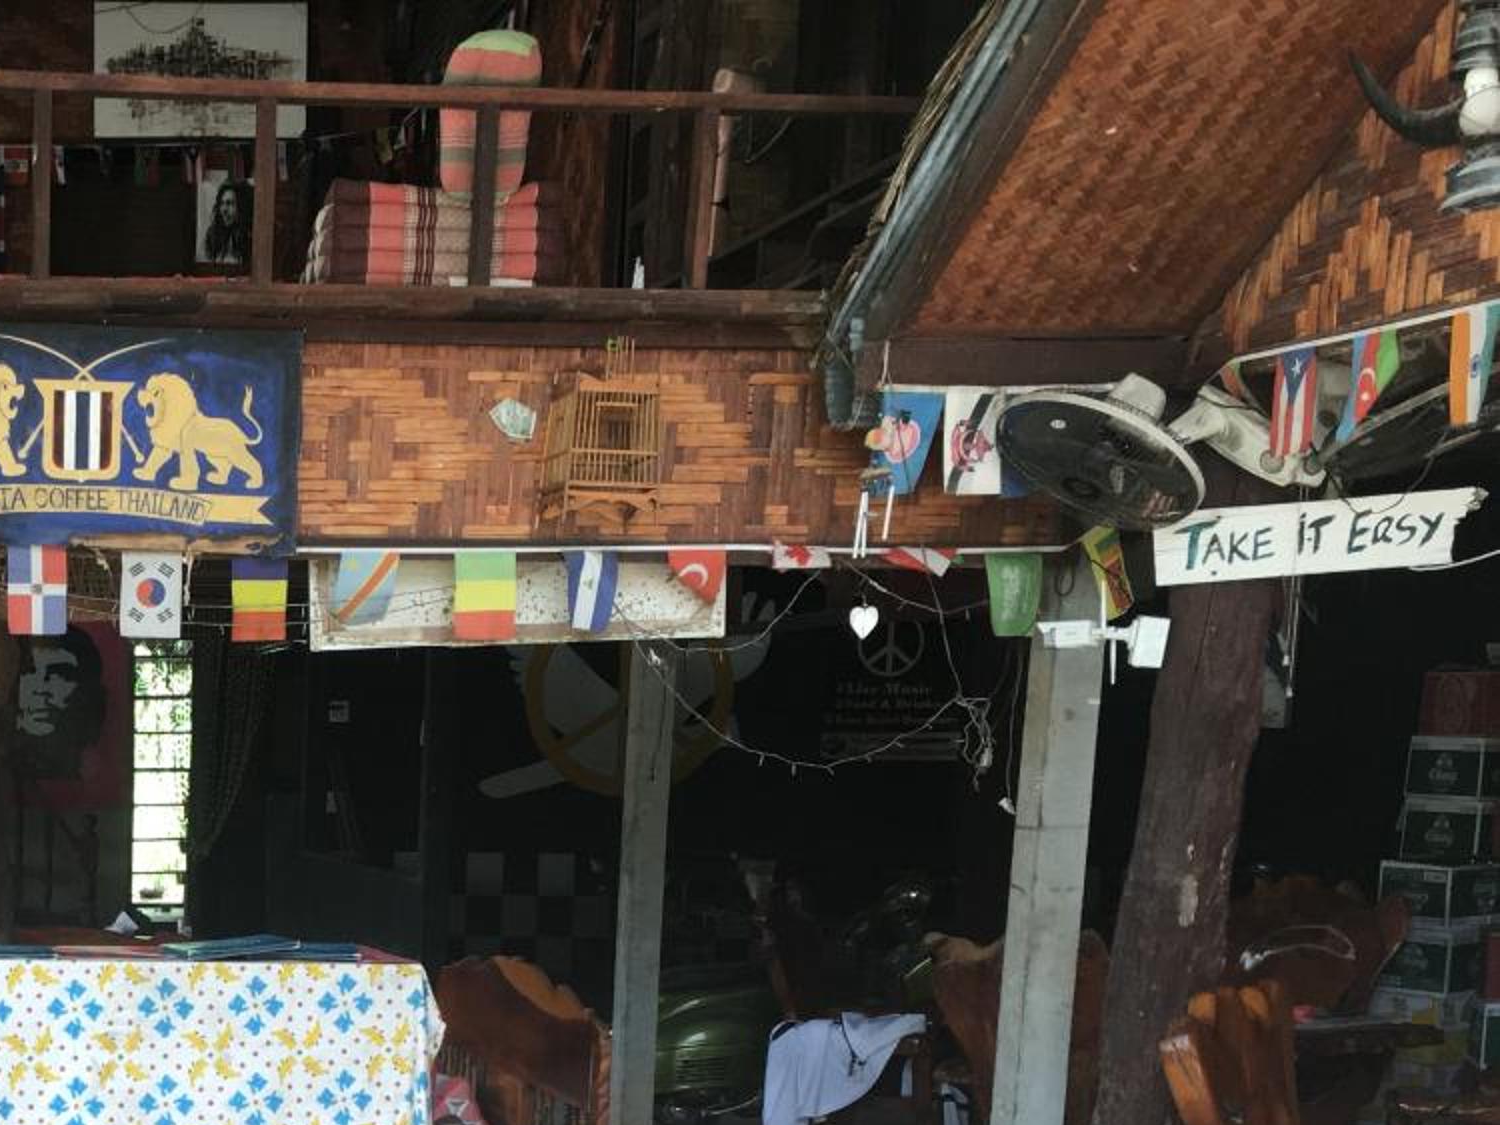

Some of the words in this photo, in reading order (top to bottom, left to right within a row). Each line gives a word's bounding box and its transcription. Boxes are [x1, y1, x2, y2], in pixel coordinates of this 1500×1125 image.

[36, 487, 109, 511] COFFEE
[116, 490, 207, 521] THAILAND
[1173, 515, 1275, 570] TAKE
